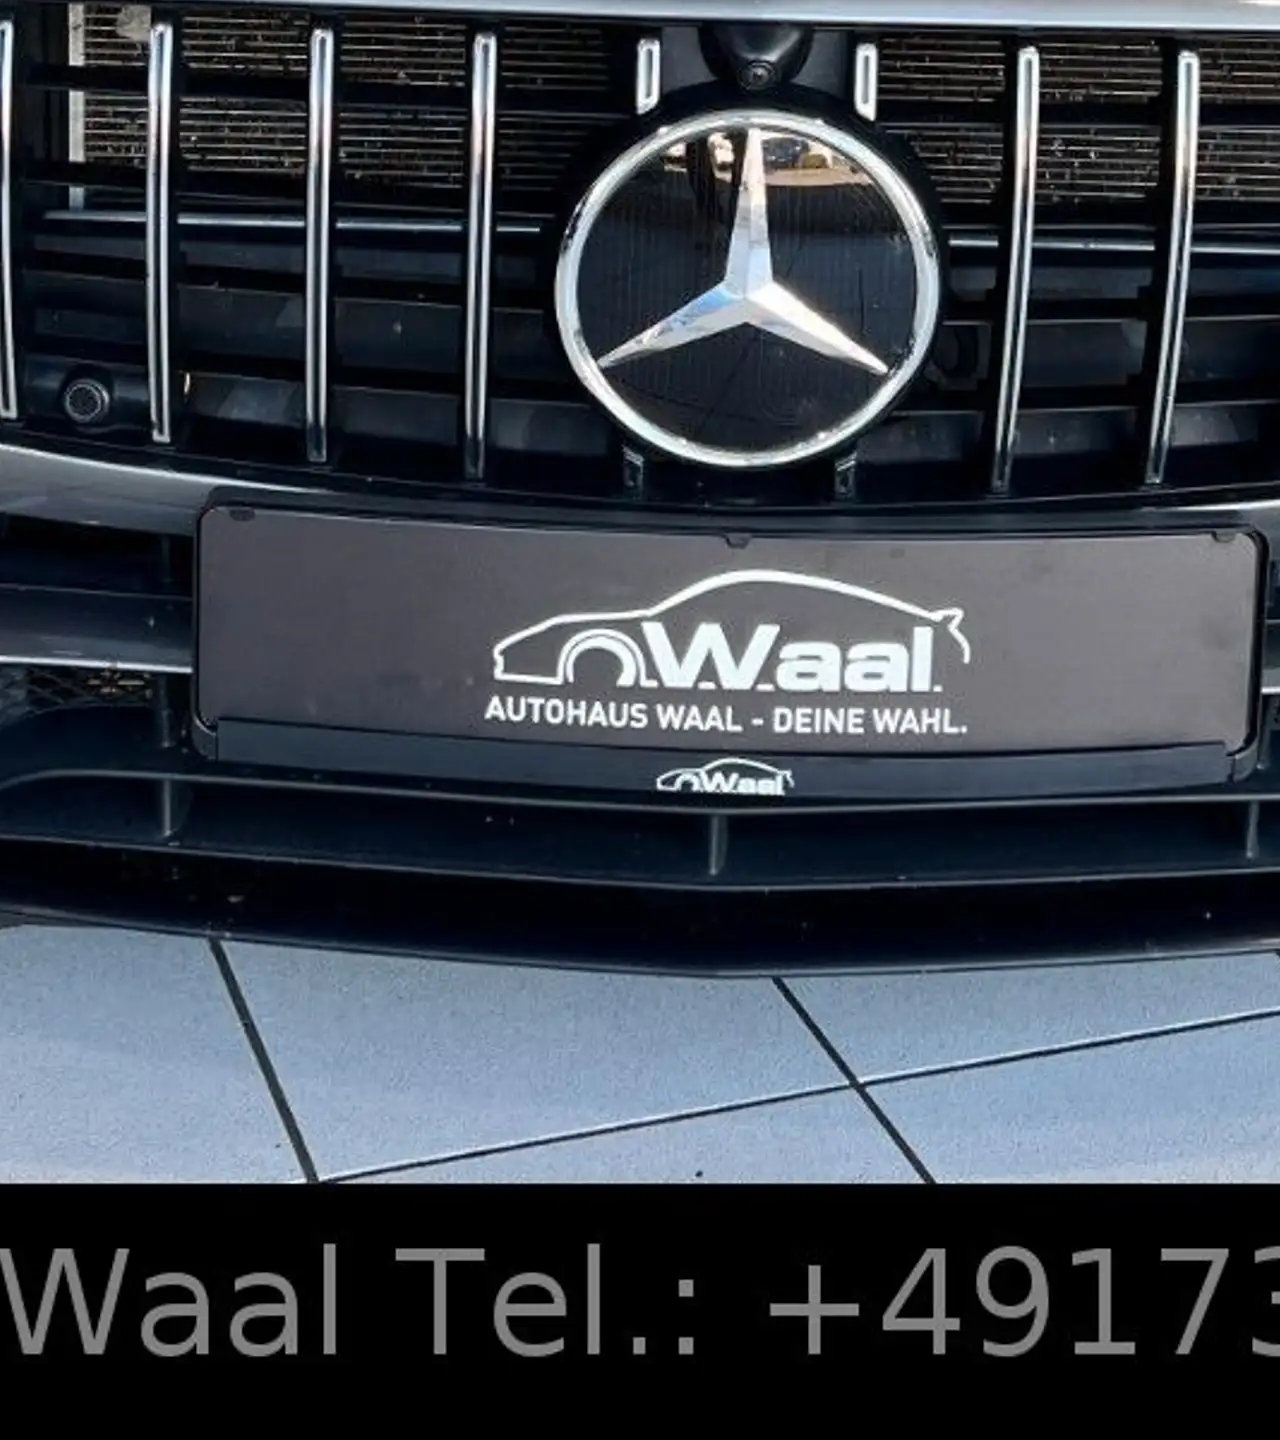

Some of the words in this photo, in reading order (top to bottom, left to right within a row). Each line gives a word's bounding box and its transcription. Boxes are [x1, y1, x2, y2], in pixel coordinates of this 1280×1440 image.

[484, 696, 649, 730] AUTOHAUS
[657, 703, 742, 732] WAAL
[773, 707, 864, 734] DEINE
[871, 707, 968, 734] WAHL.
